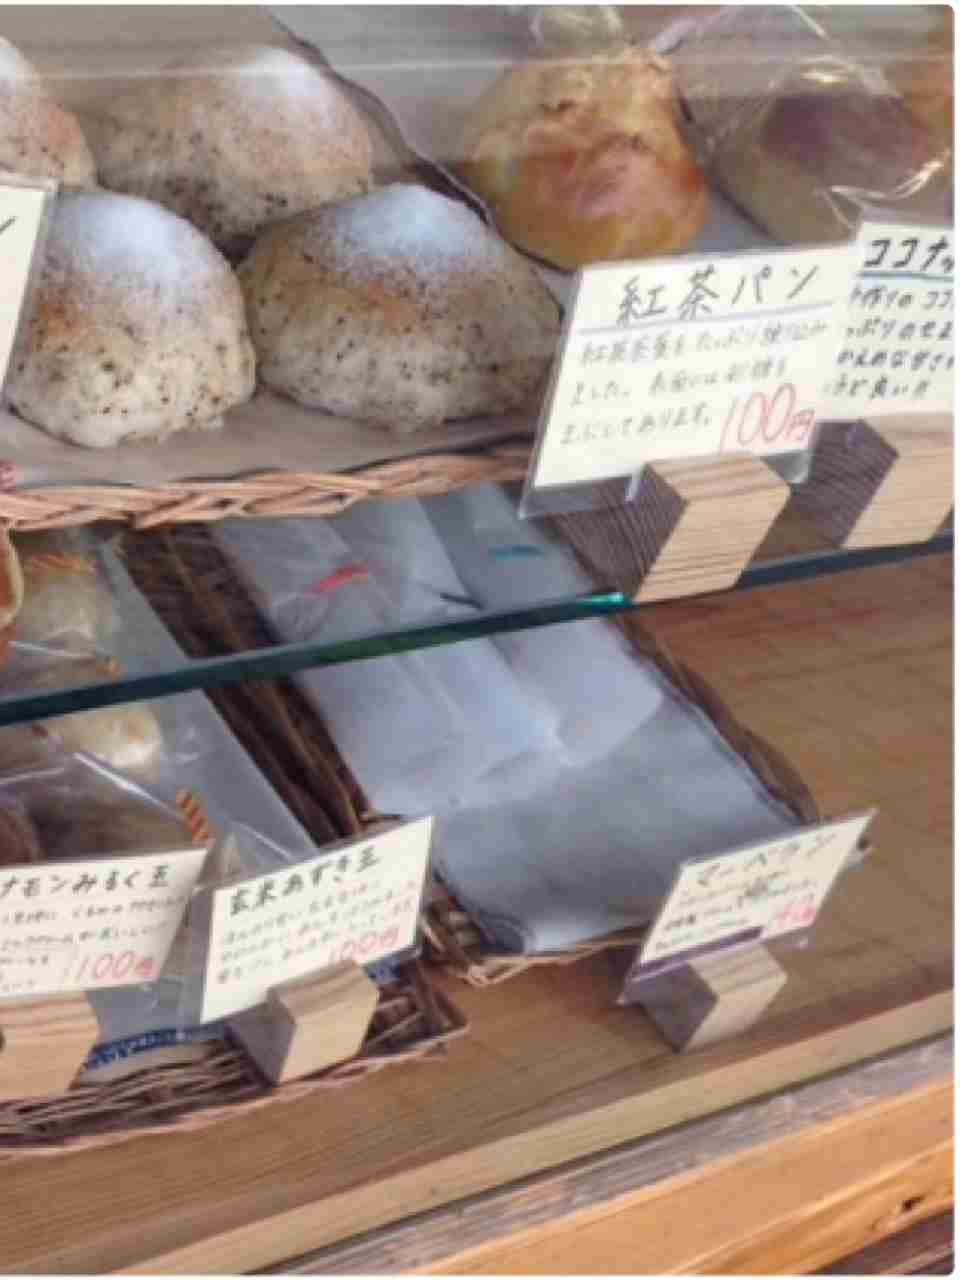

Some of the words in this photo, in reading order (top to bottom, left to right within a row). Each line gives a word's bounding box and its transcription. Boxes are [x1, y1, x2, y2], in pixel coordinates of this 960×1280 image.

[616, 264, 819, 325] 紅茶パン
[720, 382, 817, 452] 100円
